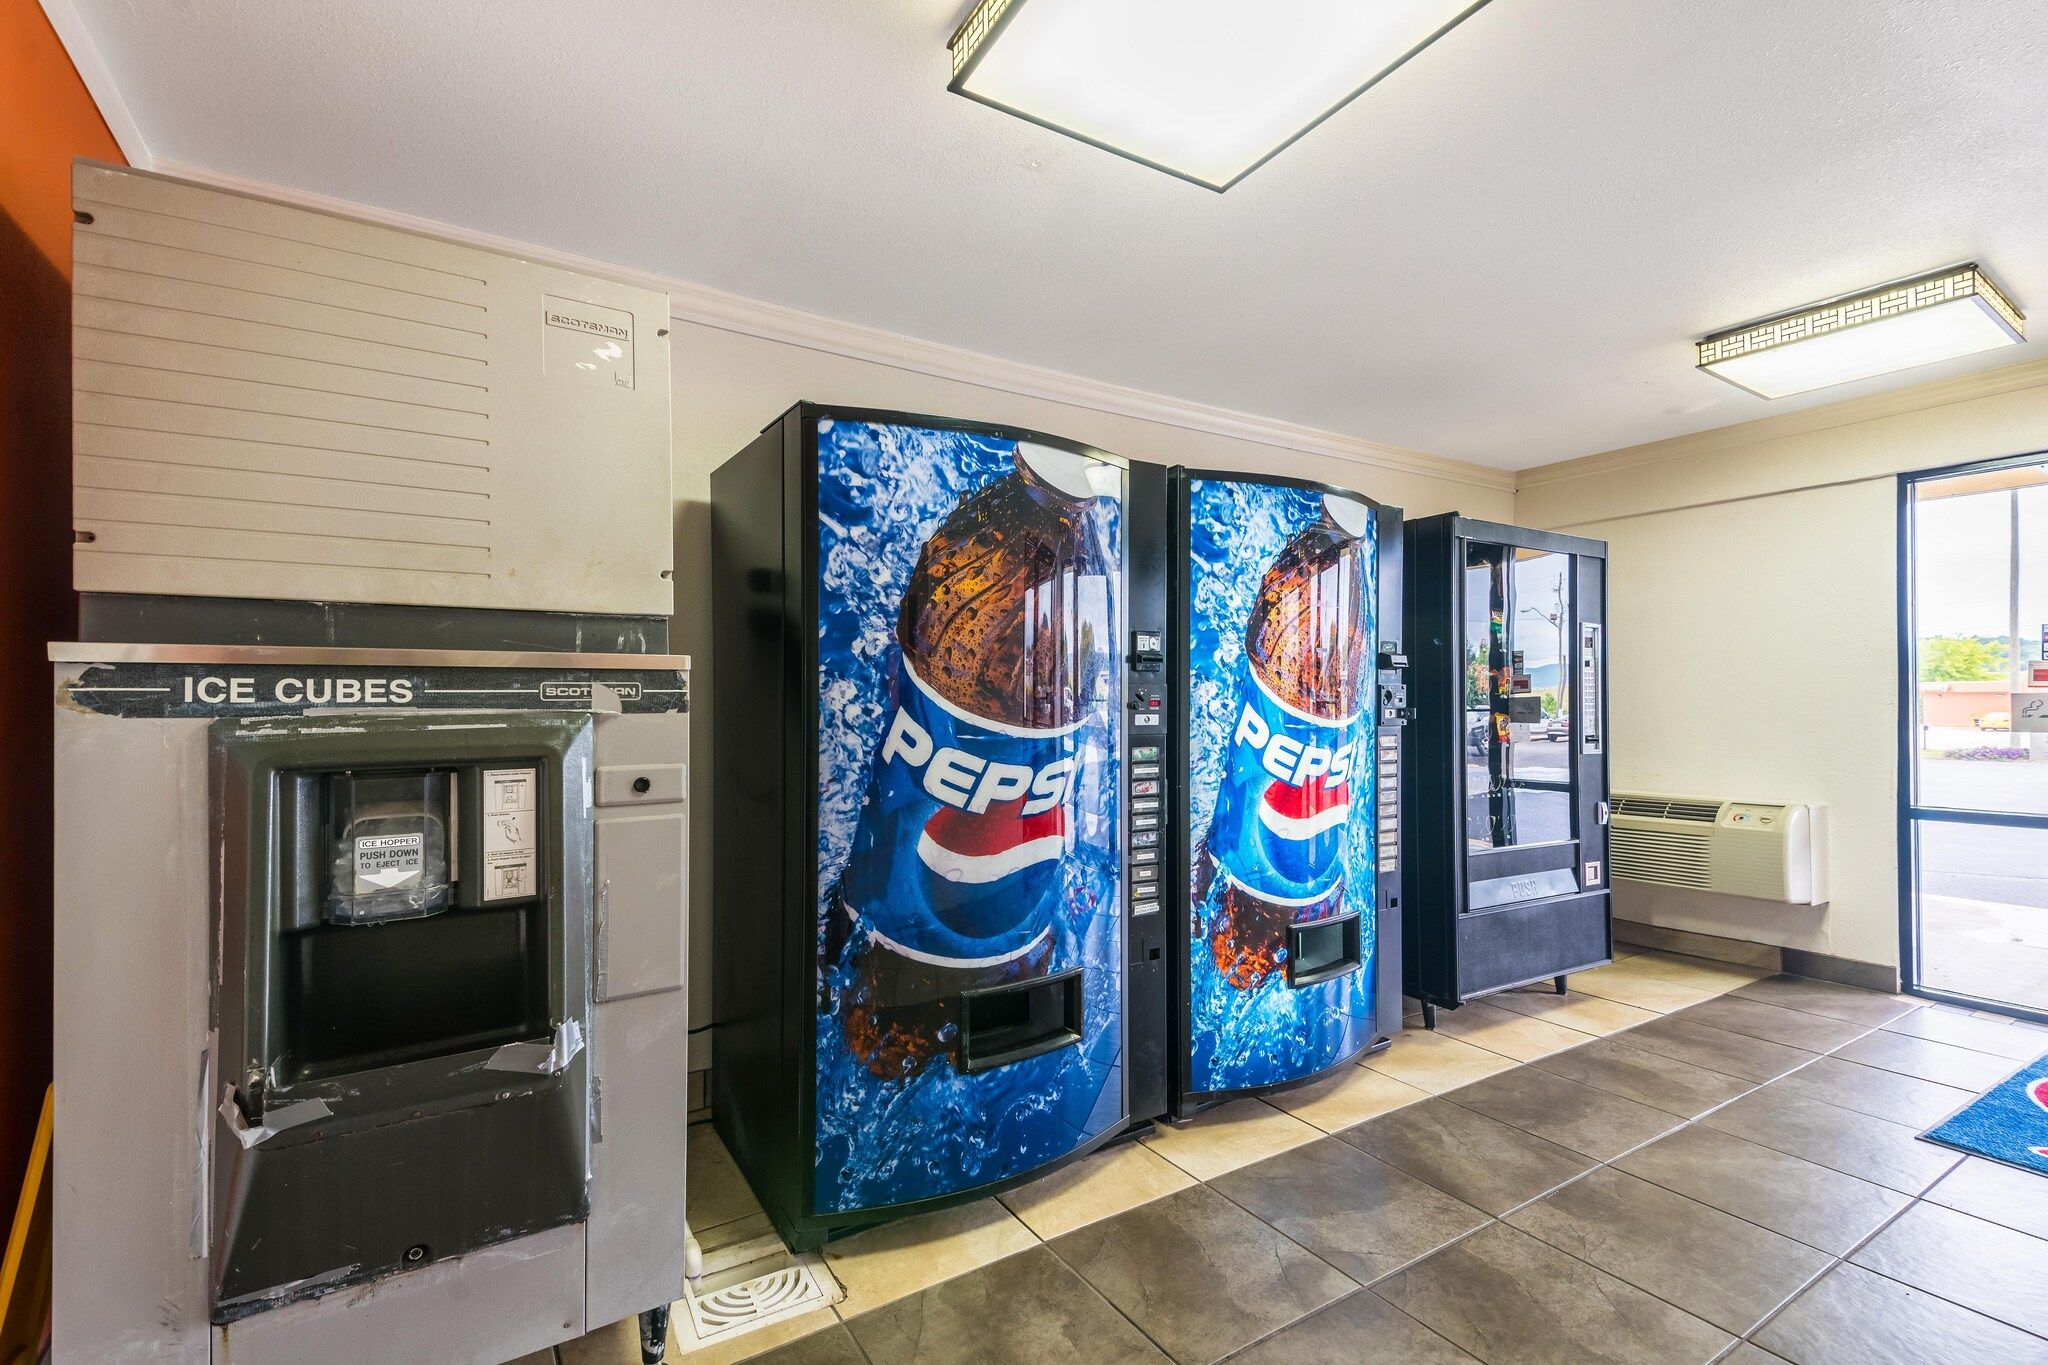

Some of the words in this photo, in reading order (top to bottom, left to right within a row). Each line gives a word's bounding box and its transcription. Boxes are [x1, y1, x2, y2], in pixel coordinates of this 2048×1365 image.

[550, 313, 628, 339] SCOTSMAN
[184, 676, 255, 703] ICE
[275, 678, 413, 703] CUBES
[545, 687, 636, 696] SCOTAN
[1234, 701, 1358, 789] PEPSI
[882, 706, 1082, 816] PEPSI
[362, 840, 377, 848] ICE
[380, 837, 418, 847] HOPPER
[360, 850, 386, 860] PUSH
[389, 848, 419, 858] DOWN
[376, 859, 400, 868] EJECT
[405, 858, 419, 866] ICE
[1510, 879, 1538, 899] PUSH
